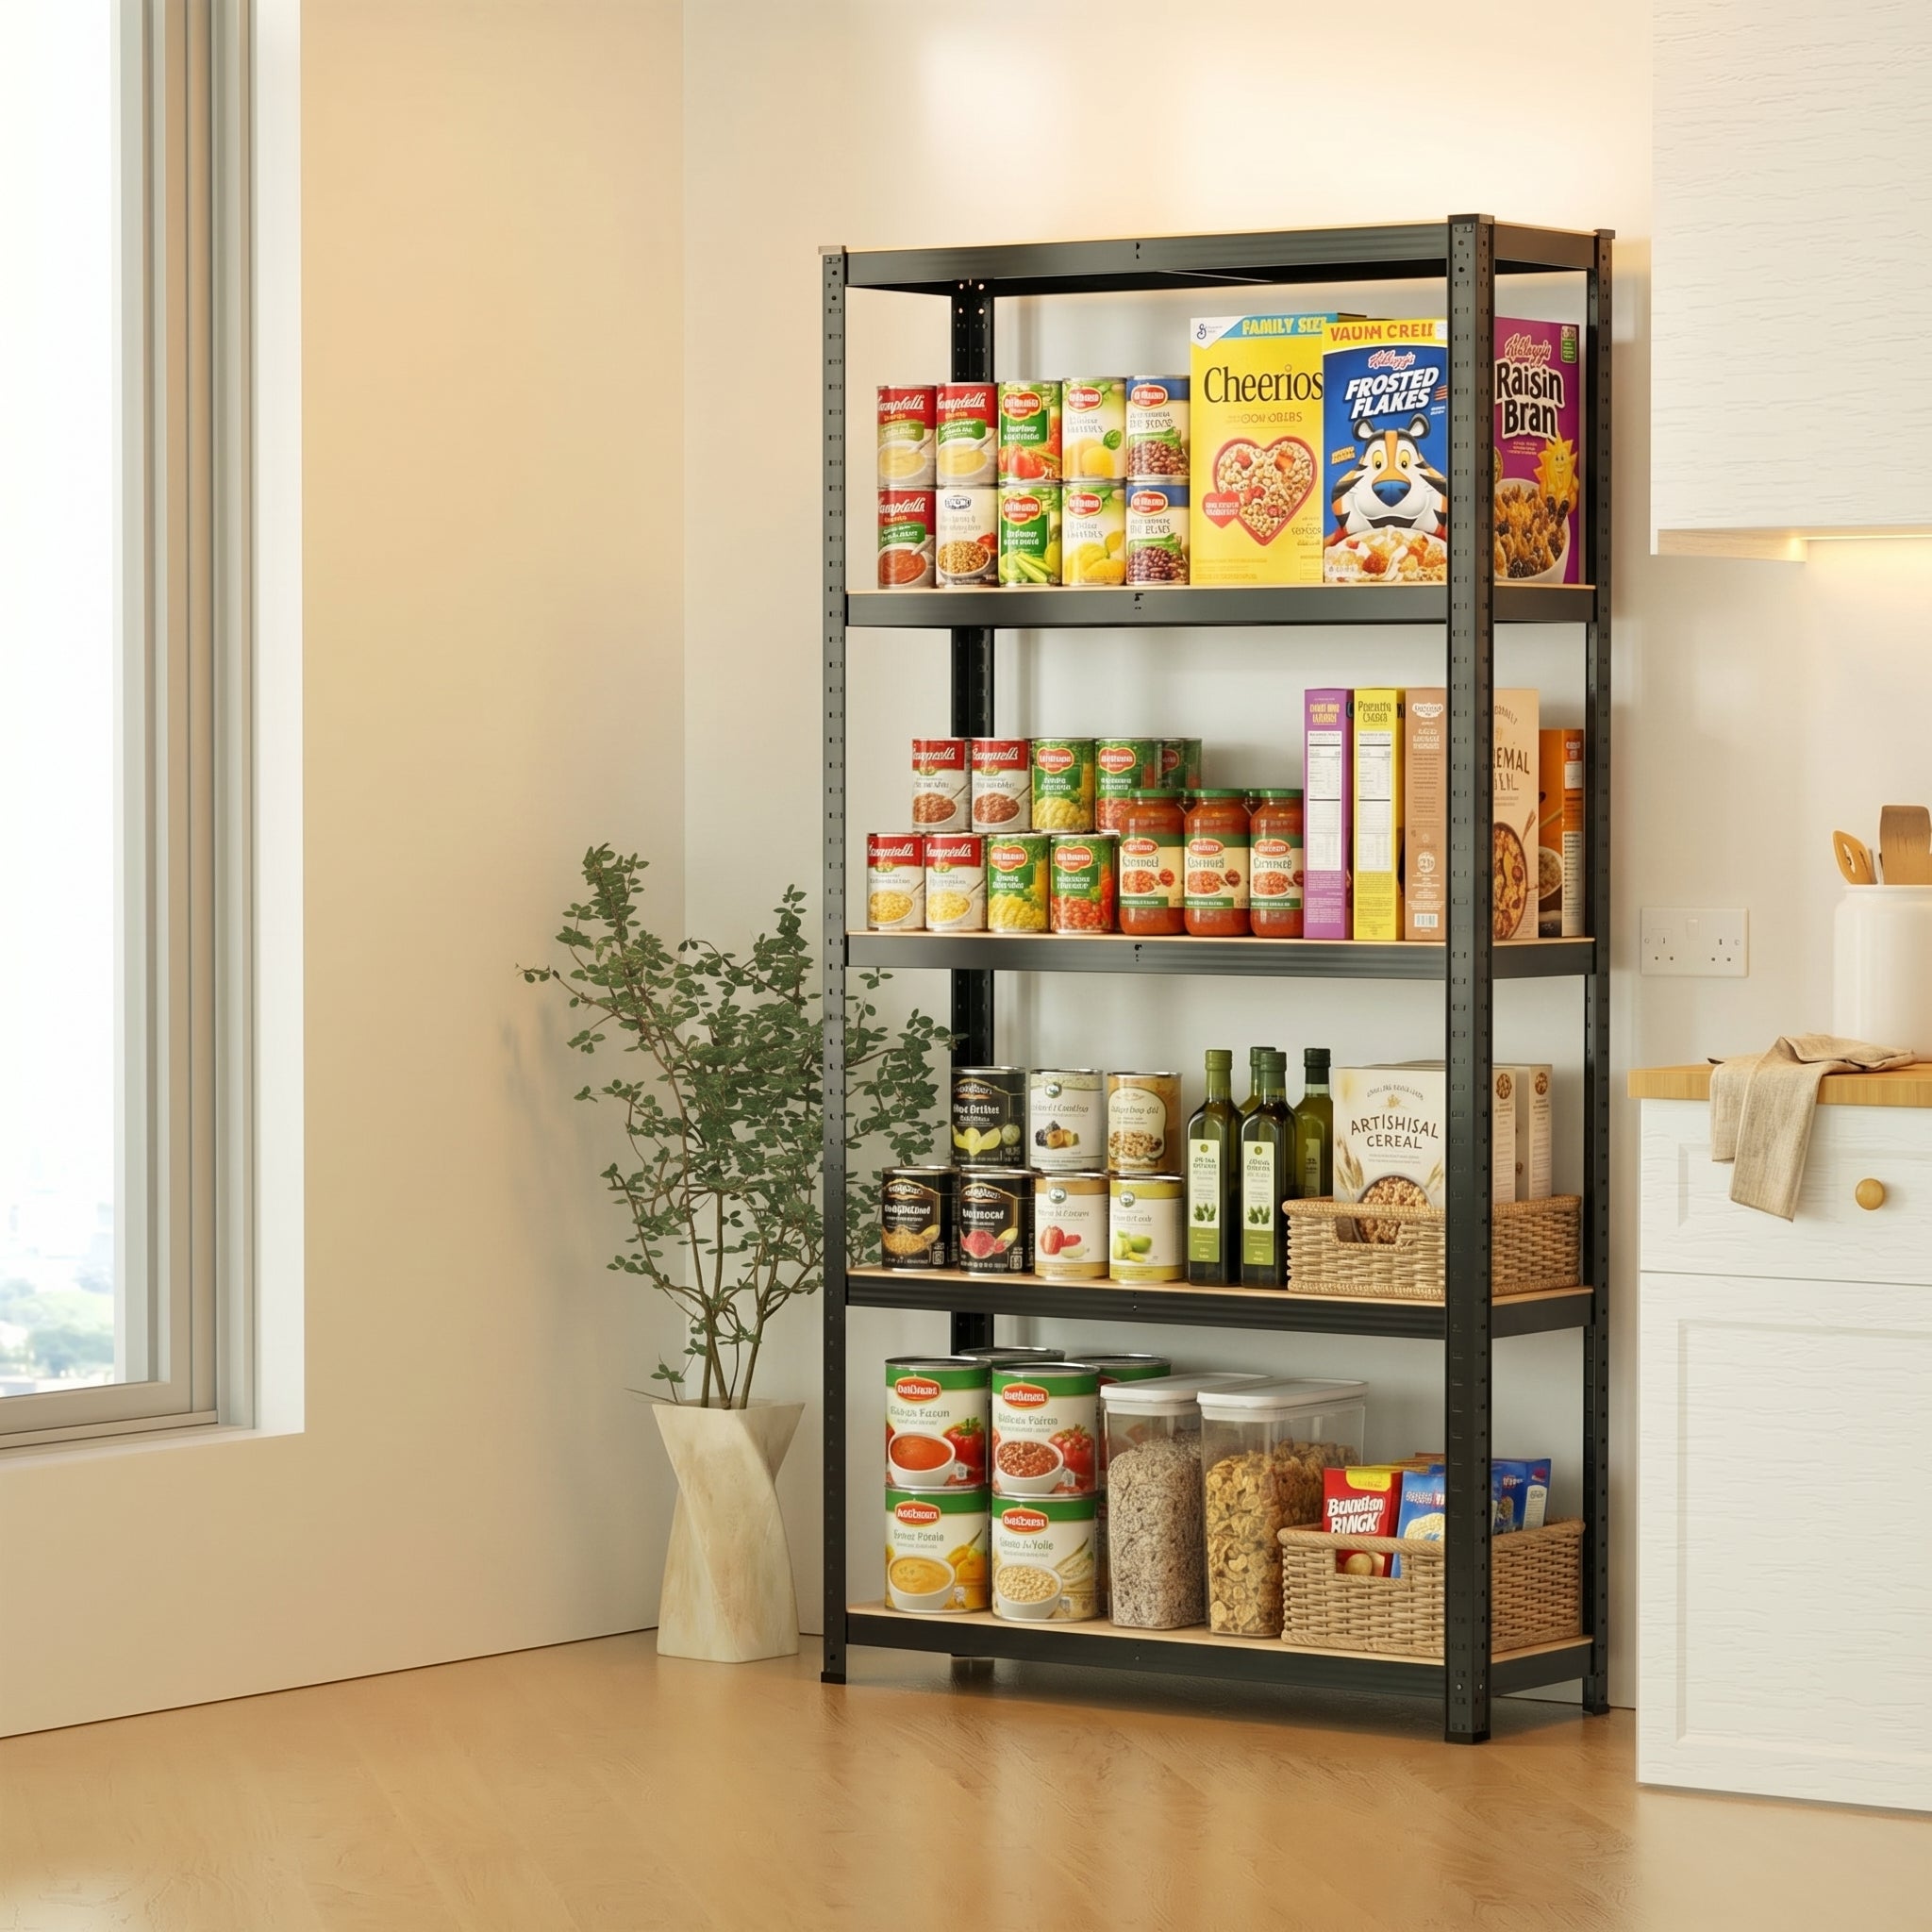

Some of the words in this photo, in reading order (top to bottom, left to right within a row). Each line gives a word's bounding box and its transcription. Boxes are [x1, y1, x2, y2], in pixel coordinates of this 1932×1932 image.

[1242, 317, 1293, 335] FAMILY
[1204, 364, 1324, 403] Cheerios
[1344, 367, 1440, 400] FROSTED
[1496, 362, 1562, 405] Raisin
[1350, 388, 1431, 419] FLAKES
[1504, 399, 1557, 438] Bran
[1493, 747, 1530, 774] EMAL
[1351, 1114, 1439, 1139] ARTISHISAL
[1367, 1134, 1423, 1149] CEREAL
